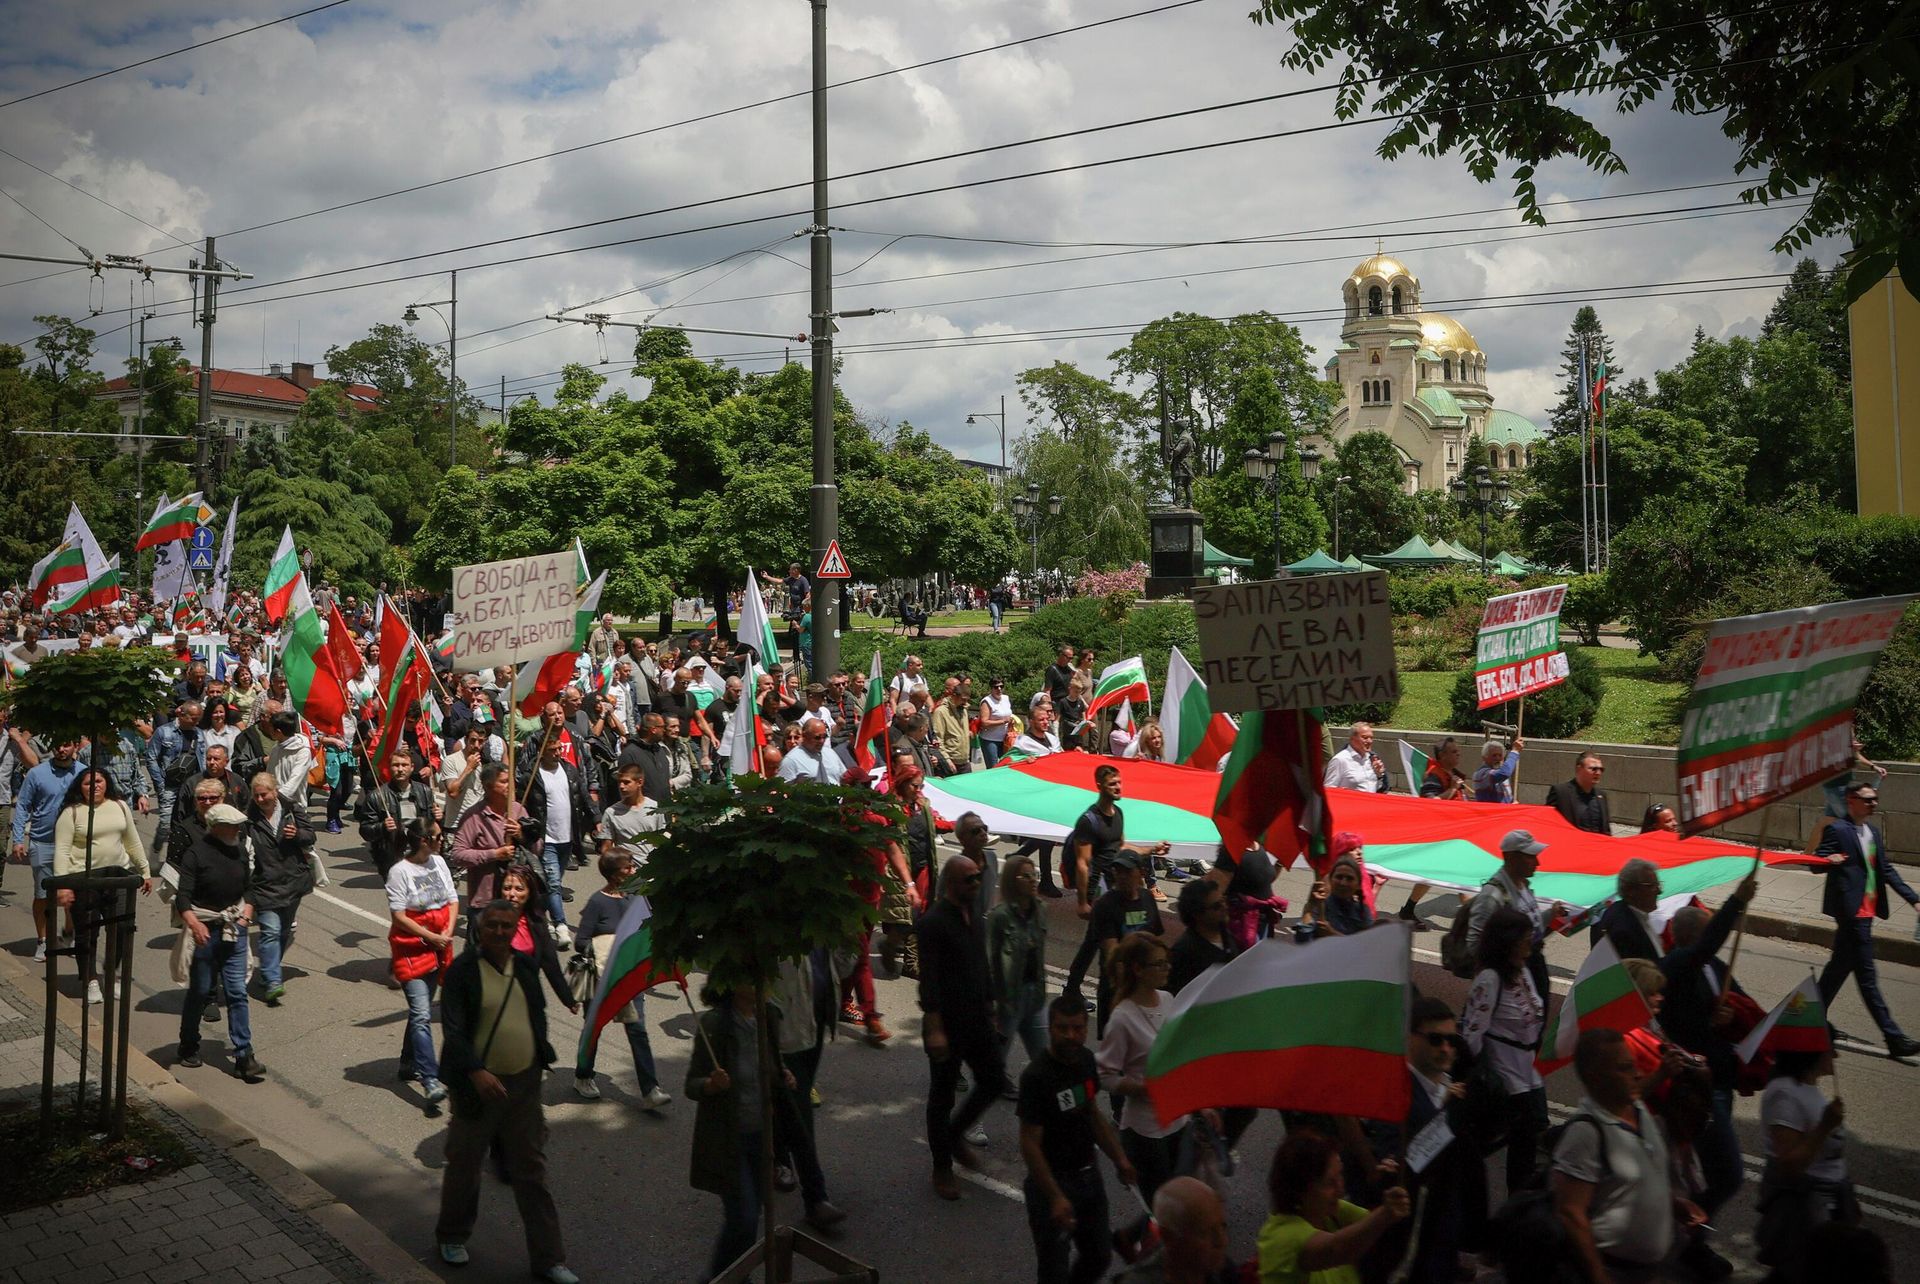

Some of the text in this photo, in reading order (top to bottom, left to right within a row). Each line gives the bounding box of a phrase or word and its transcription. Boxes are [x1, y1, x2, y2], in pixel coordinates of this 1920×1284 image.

[456, 558, 559, 600] СВОБОДА
[1193, 575, 1388, 620] ЗАПАЗВАМЕ
[453, 611, 471, 626] ЗА
[1250, 613, 1366, 652] ЛЕВА!
[453, 626, 512, 658] СМЪРТ
[1256, 667, 1400, 711] БИТКАТА!
